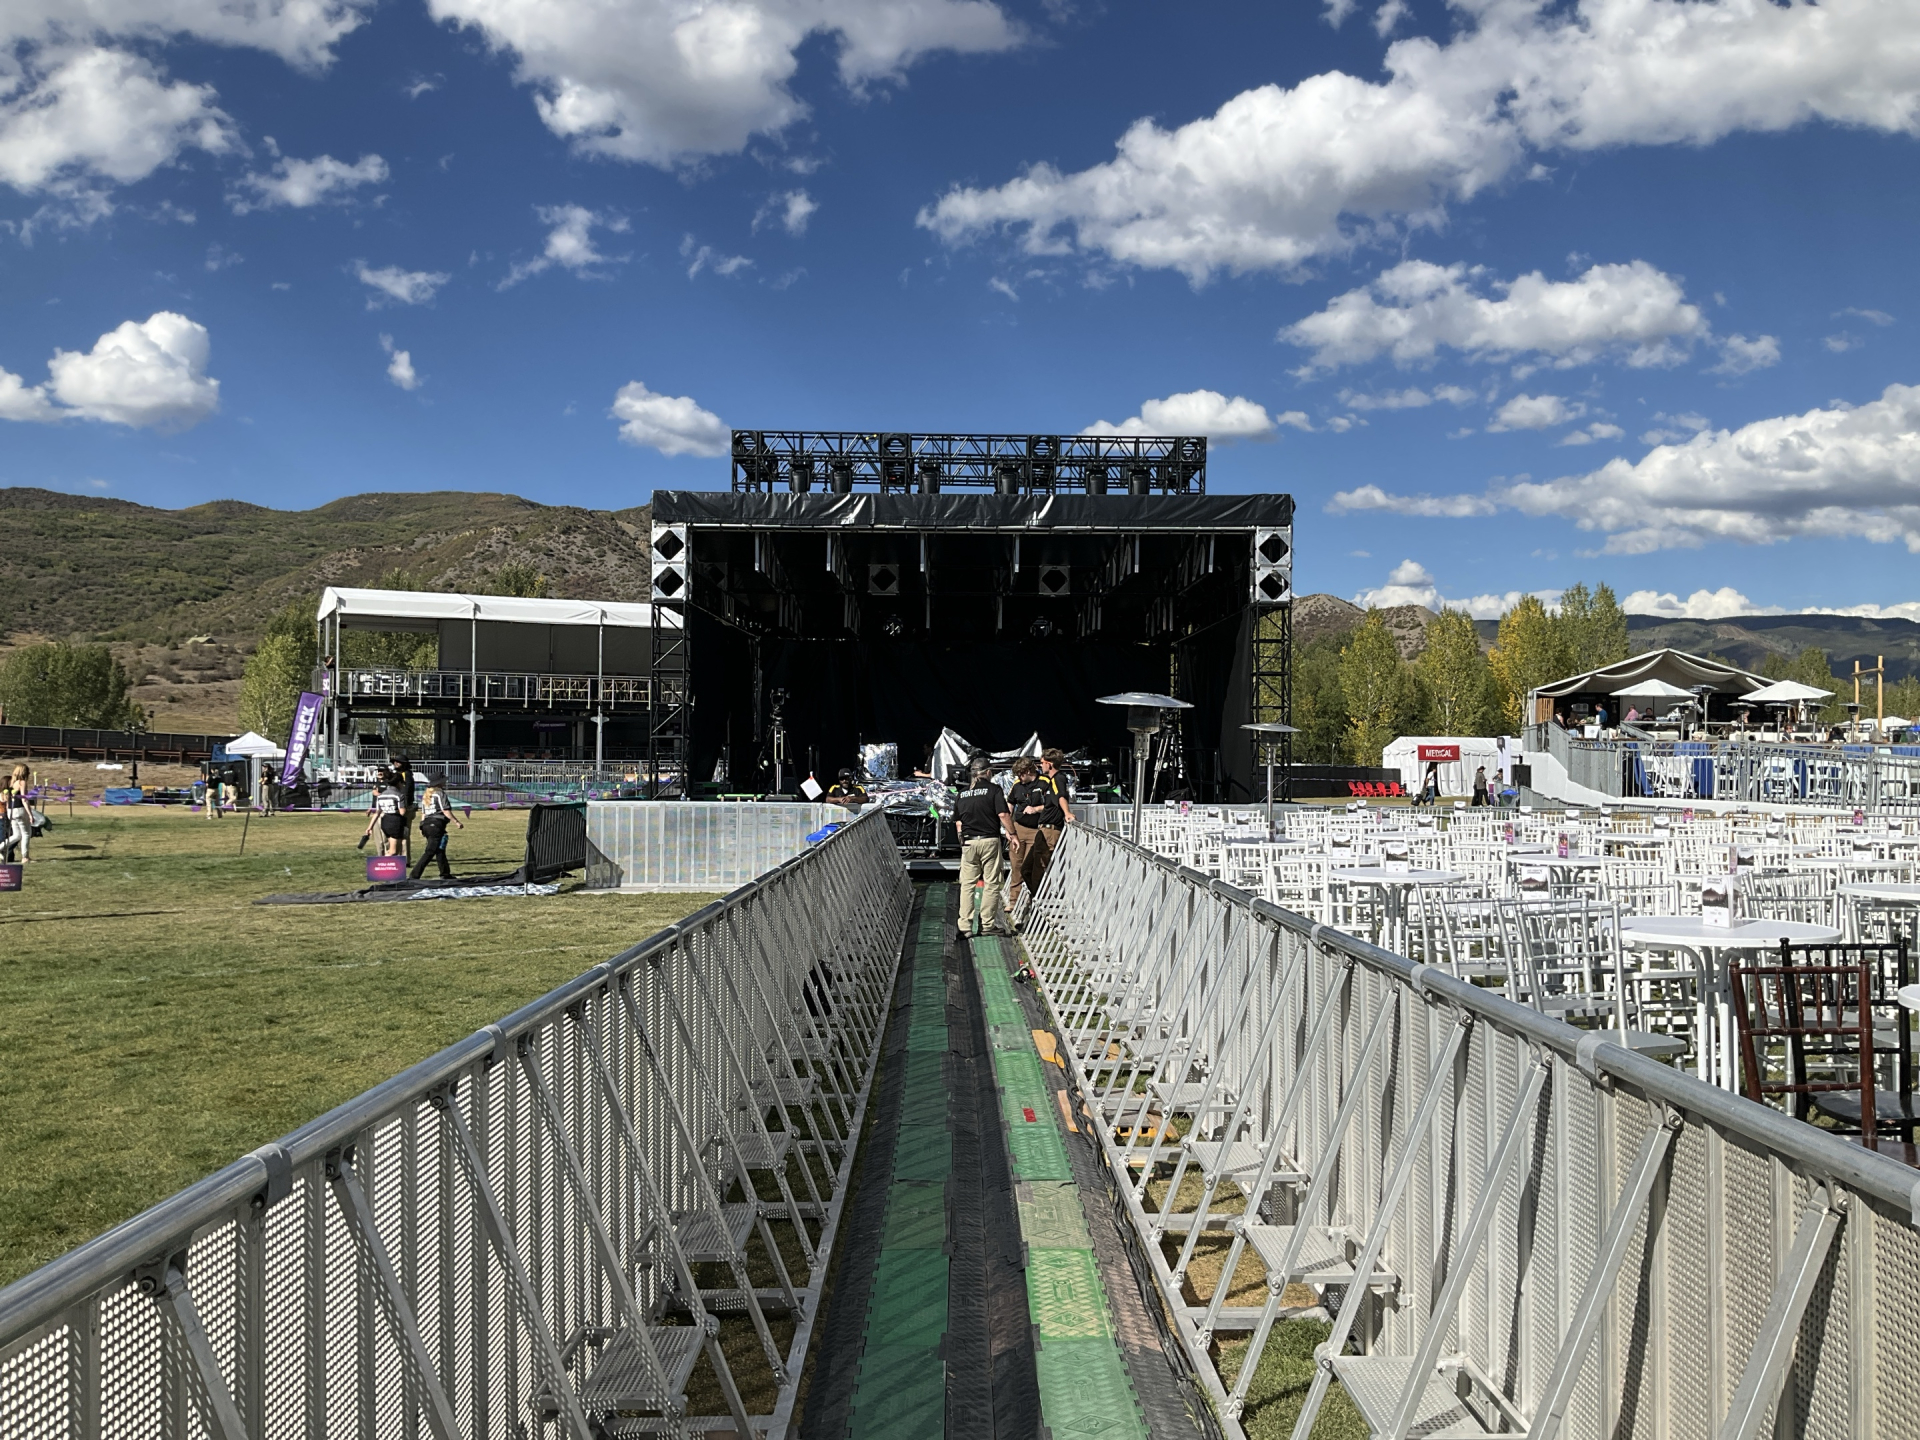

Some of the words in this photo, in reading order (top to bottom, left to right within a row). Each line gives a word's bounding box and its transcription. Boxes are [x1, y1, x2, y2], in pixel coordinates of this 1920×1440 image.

[295, 705, 316, 742] DECK
[289, 742, 305, 768] JAS
[1425, 749, 1453, 758] MEDICAL
[960, 789, 974, 799] EVENT
[974, 788, 988, 796] STAFF
